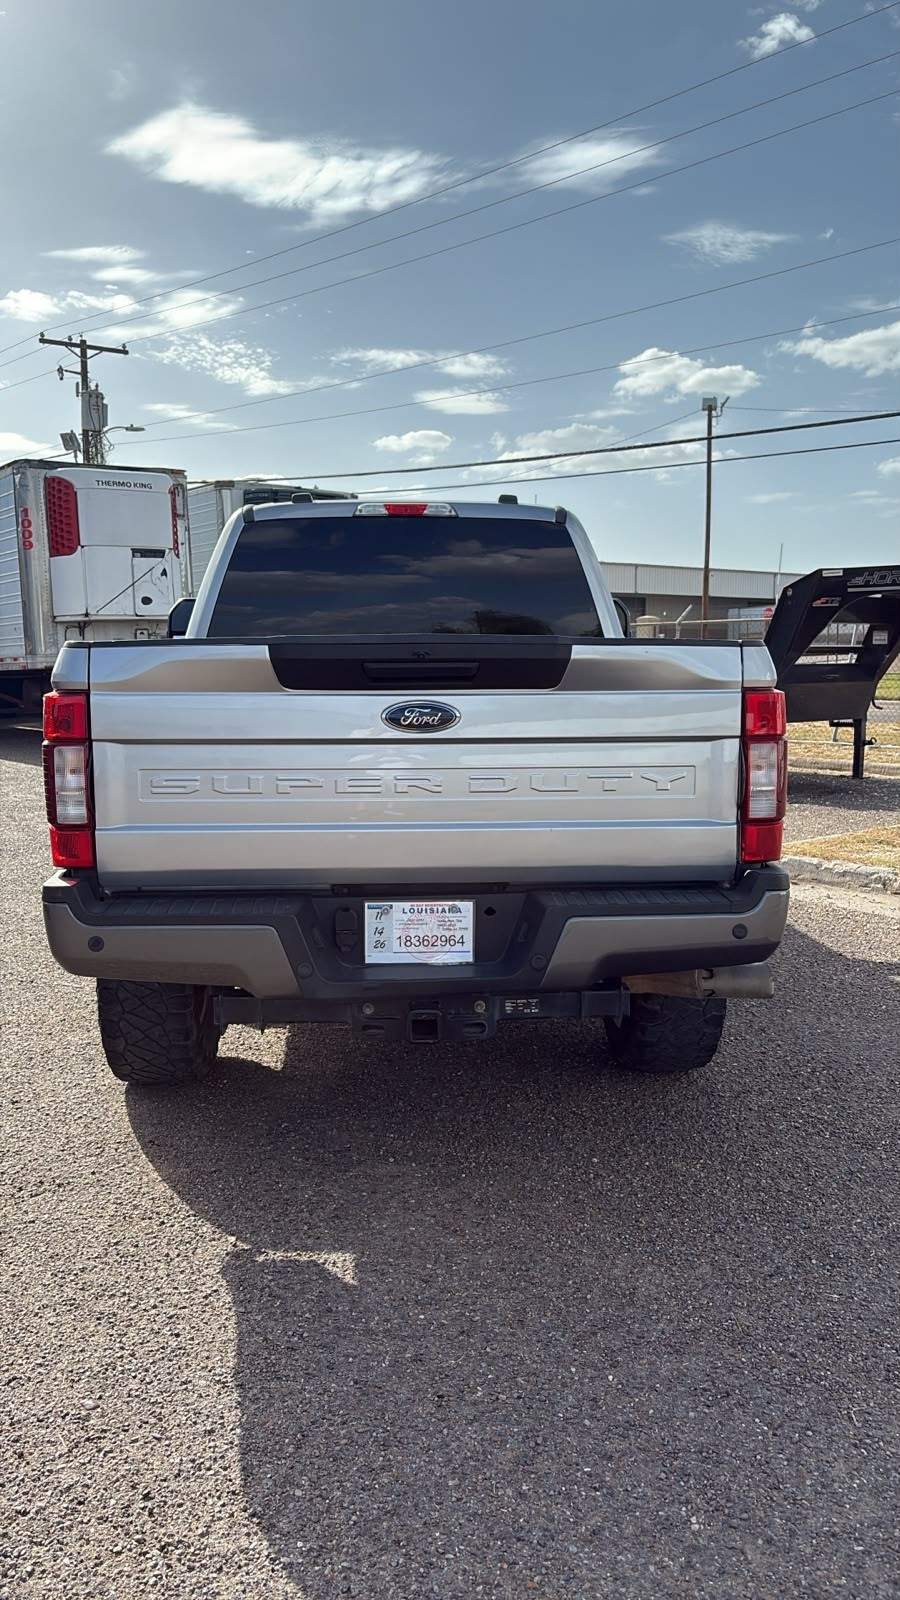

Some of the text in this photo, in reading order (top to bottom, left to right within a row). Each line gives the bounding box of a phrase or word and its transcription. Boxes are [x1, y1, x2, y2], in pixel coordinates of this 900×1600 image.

[95, 479, 153, 490] THERMO KING
[20, 507, 34, 551] 1009
[398, 706, 443, 727] Ford
[149, 771, 688, 795] SUPER DUTY
[373, 939, 386, 949] 26
[396, 934, 466, 948] 18362964
